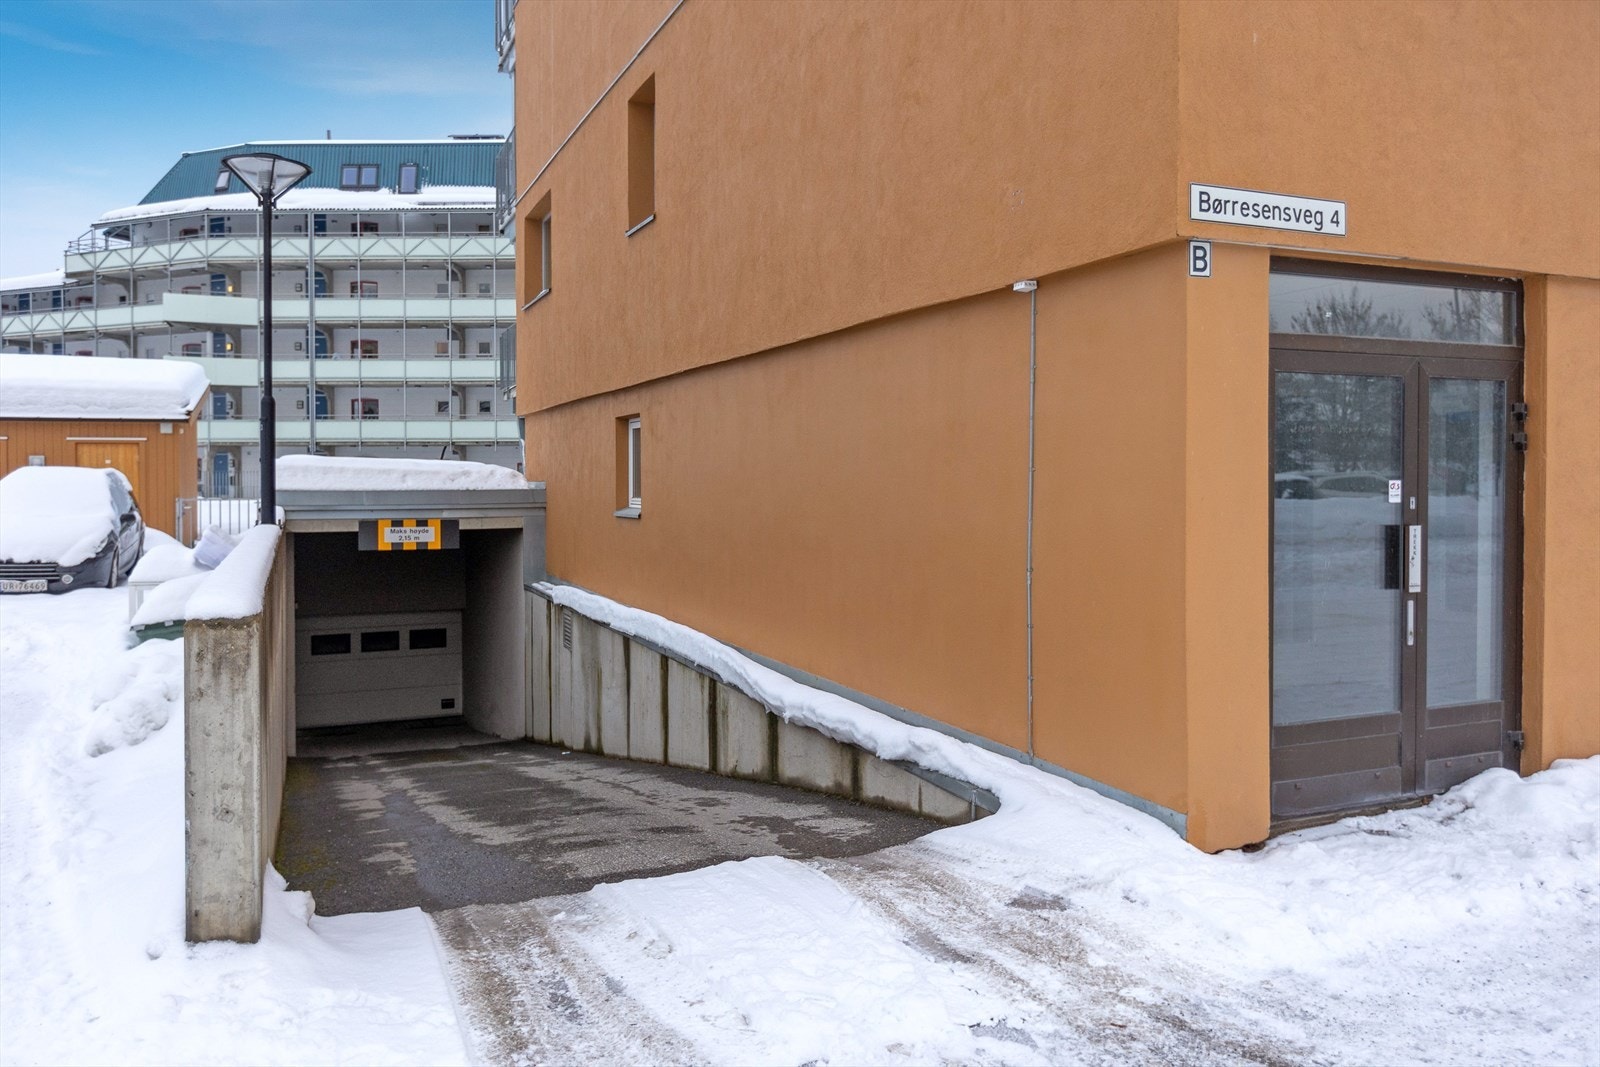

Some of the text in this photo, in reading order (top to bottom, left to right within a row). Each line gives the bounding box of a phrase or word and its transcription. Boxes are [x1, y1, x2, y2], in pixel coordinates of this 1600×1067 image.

[1198, 191, 1340, 231] Børresensveg 4
[1193, 246, 1208, 273] B
